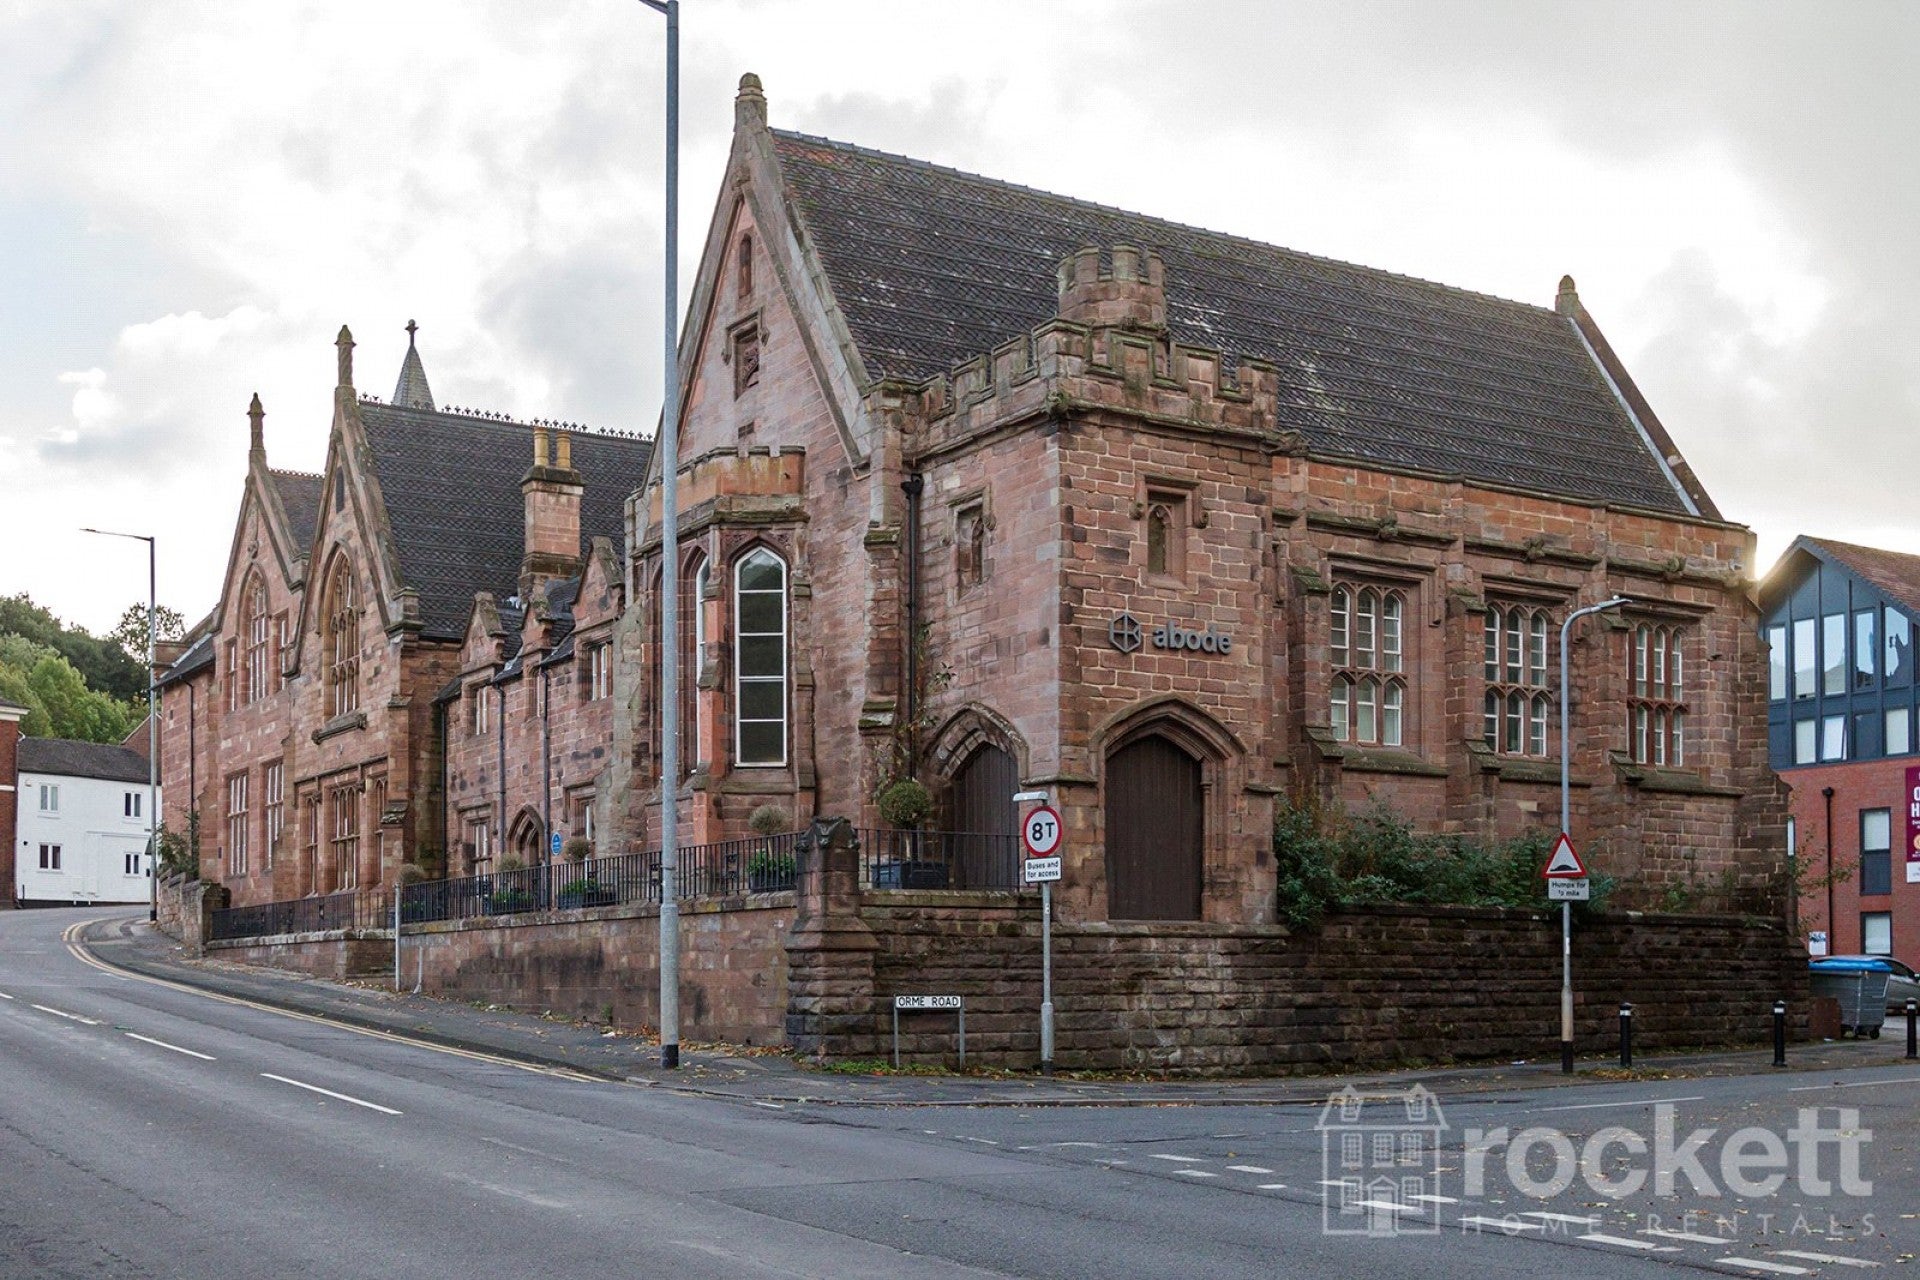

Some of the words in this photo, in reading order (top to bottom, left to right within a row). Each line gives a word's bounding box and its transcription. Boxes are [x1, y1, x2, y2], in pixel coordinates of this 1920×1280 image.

[1153, 620, 1232, 655] abode
[1032, 822, 1055, 841] 8T
[1027, 862, 1045, 870] Buses
[1047, 860, 1059, 868] and
[898, 997, 925, 1006] ORME
[932, 996, 959, 1006] ROAD
